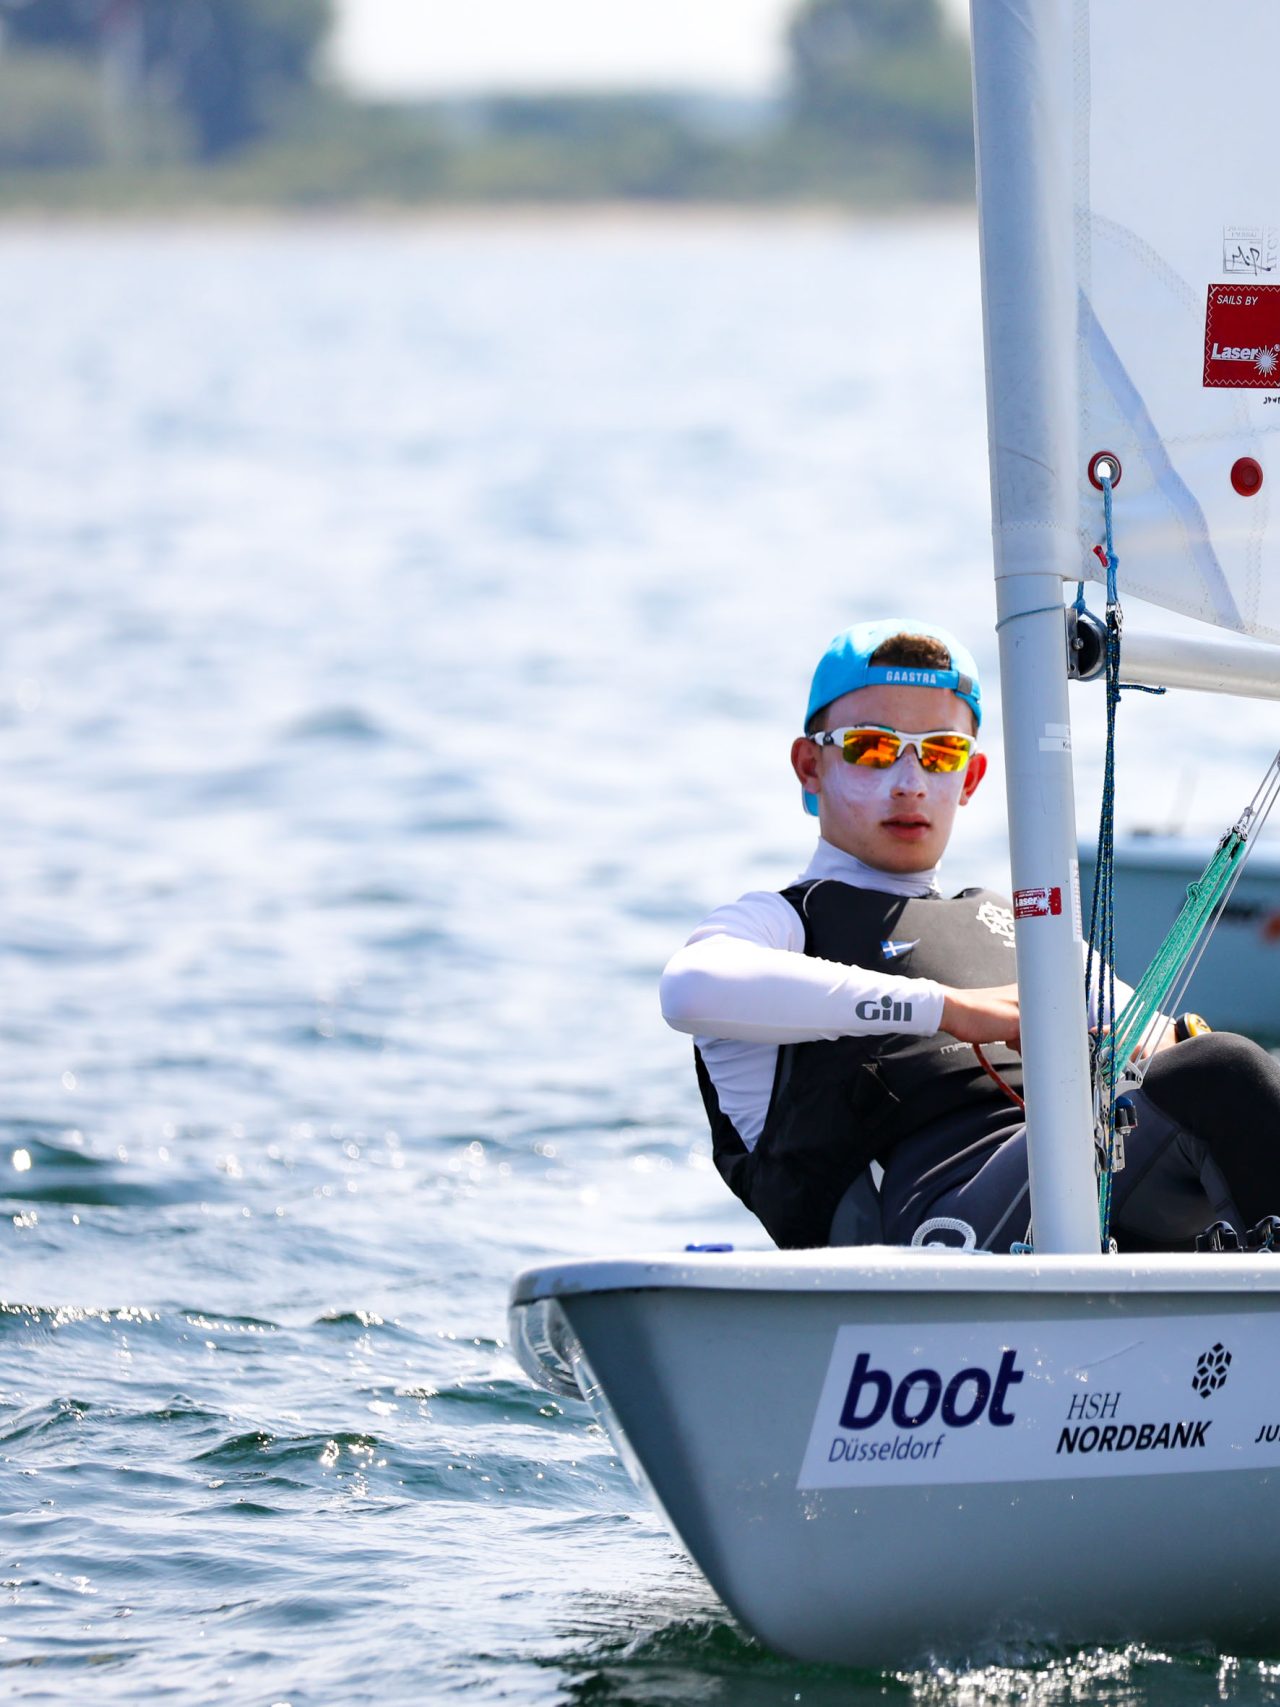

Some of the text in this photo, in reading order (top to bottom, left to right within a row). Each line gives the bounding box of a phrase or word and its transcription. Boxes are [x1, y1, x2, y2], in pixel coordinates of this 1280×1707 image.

[1216, 294, 1258, 306] SAILS BY
[1211, 342, 1259, 360] Laser
[886, 670, 937, 685] GAASTRA
[855, 995, 912, 1022] Gill
[838, 1349, 1024, 1430] boot
[1066, 1392, 1121, 1420] HSH
[828, 1433, 945, 1462] Düsseldorf
[1056, 1421, 1212, 1454] NORDBANK
